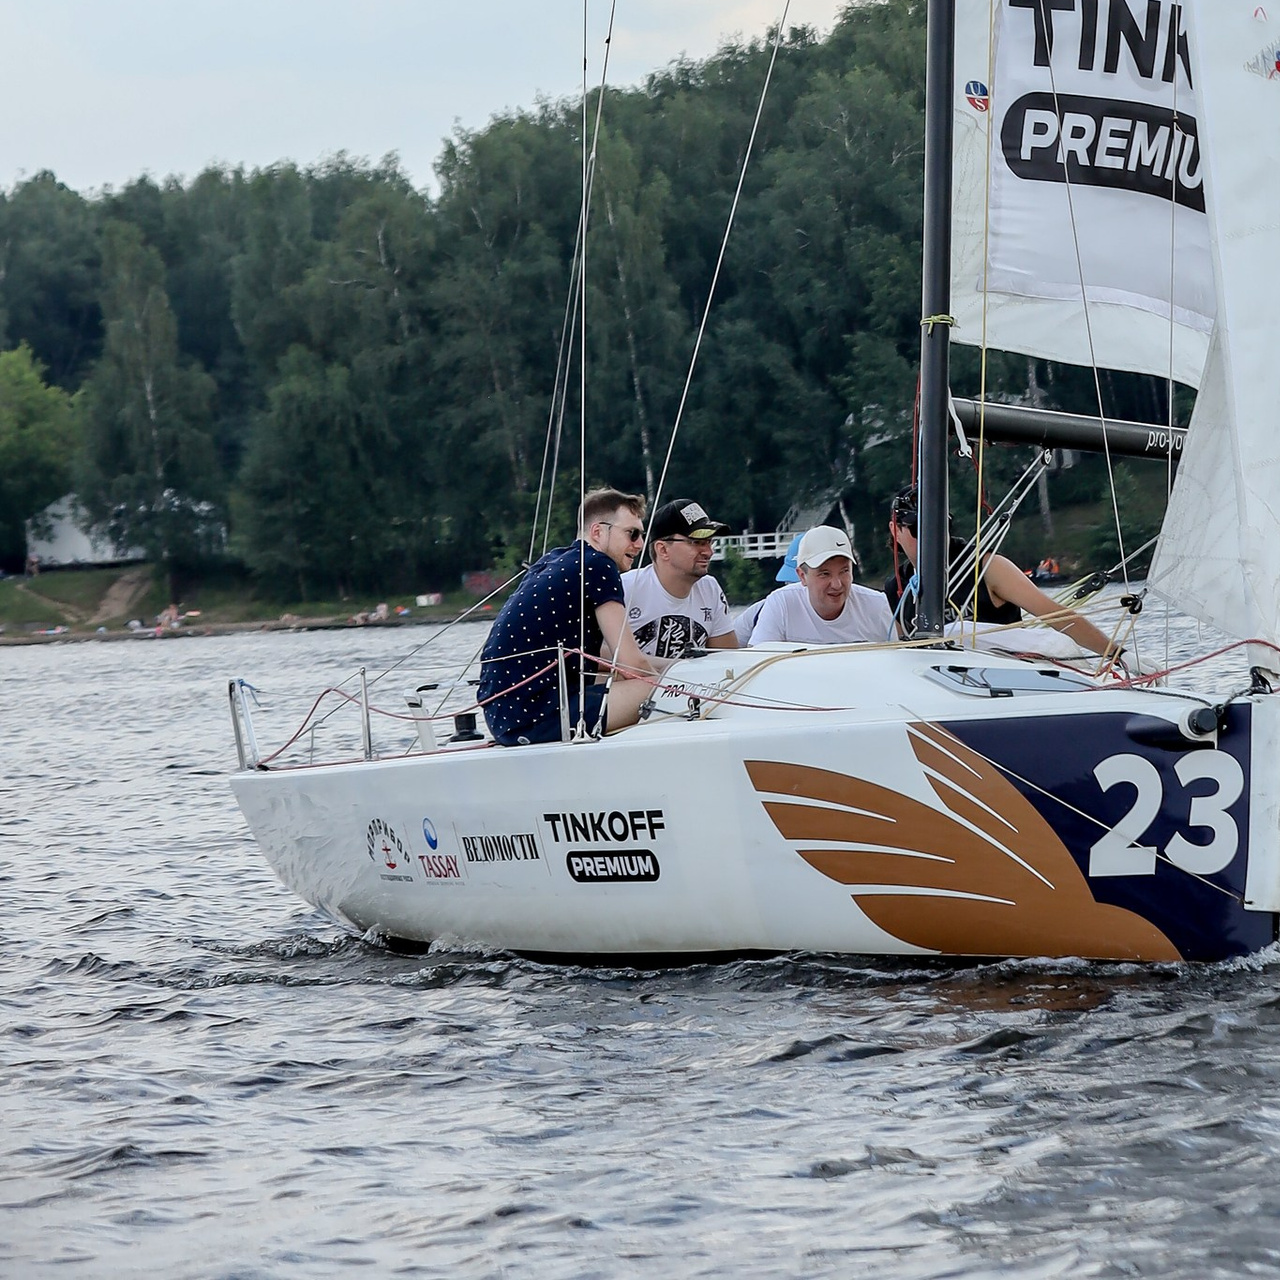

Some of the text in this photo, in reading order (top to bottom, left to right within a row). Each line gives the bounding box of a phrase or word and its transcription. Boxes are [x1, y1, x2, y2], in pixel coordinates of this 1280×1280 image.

[543, 809, 666, 843] TINKOFF
[1088, 748, 1245, 877] 23
[418, 855, 461, 878] TASSAY
[570, 855, 655, 876] PREMIUM
